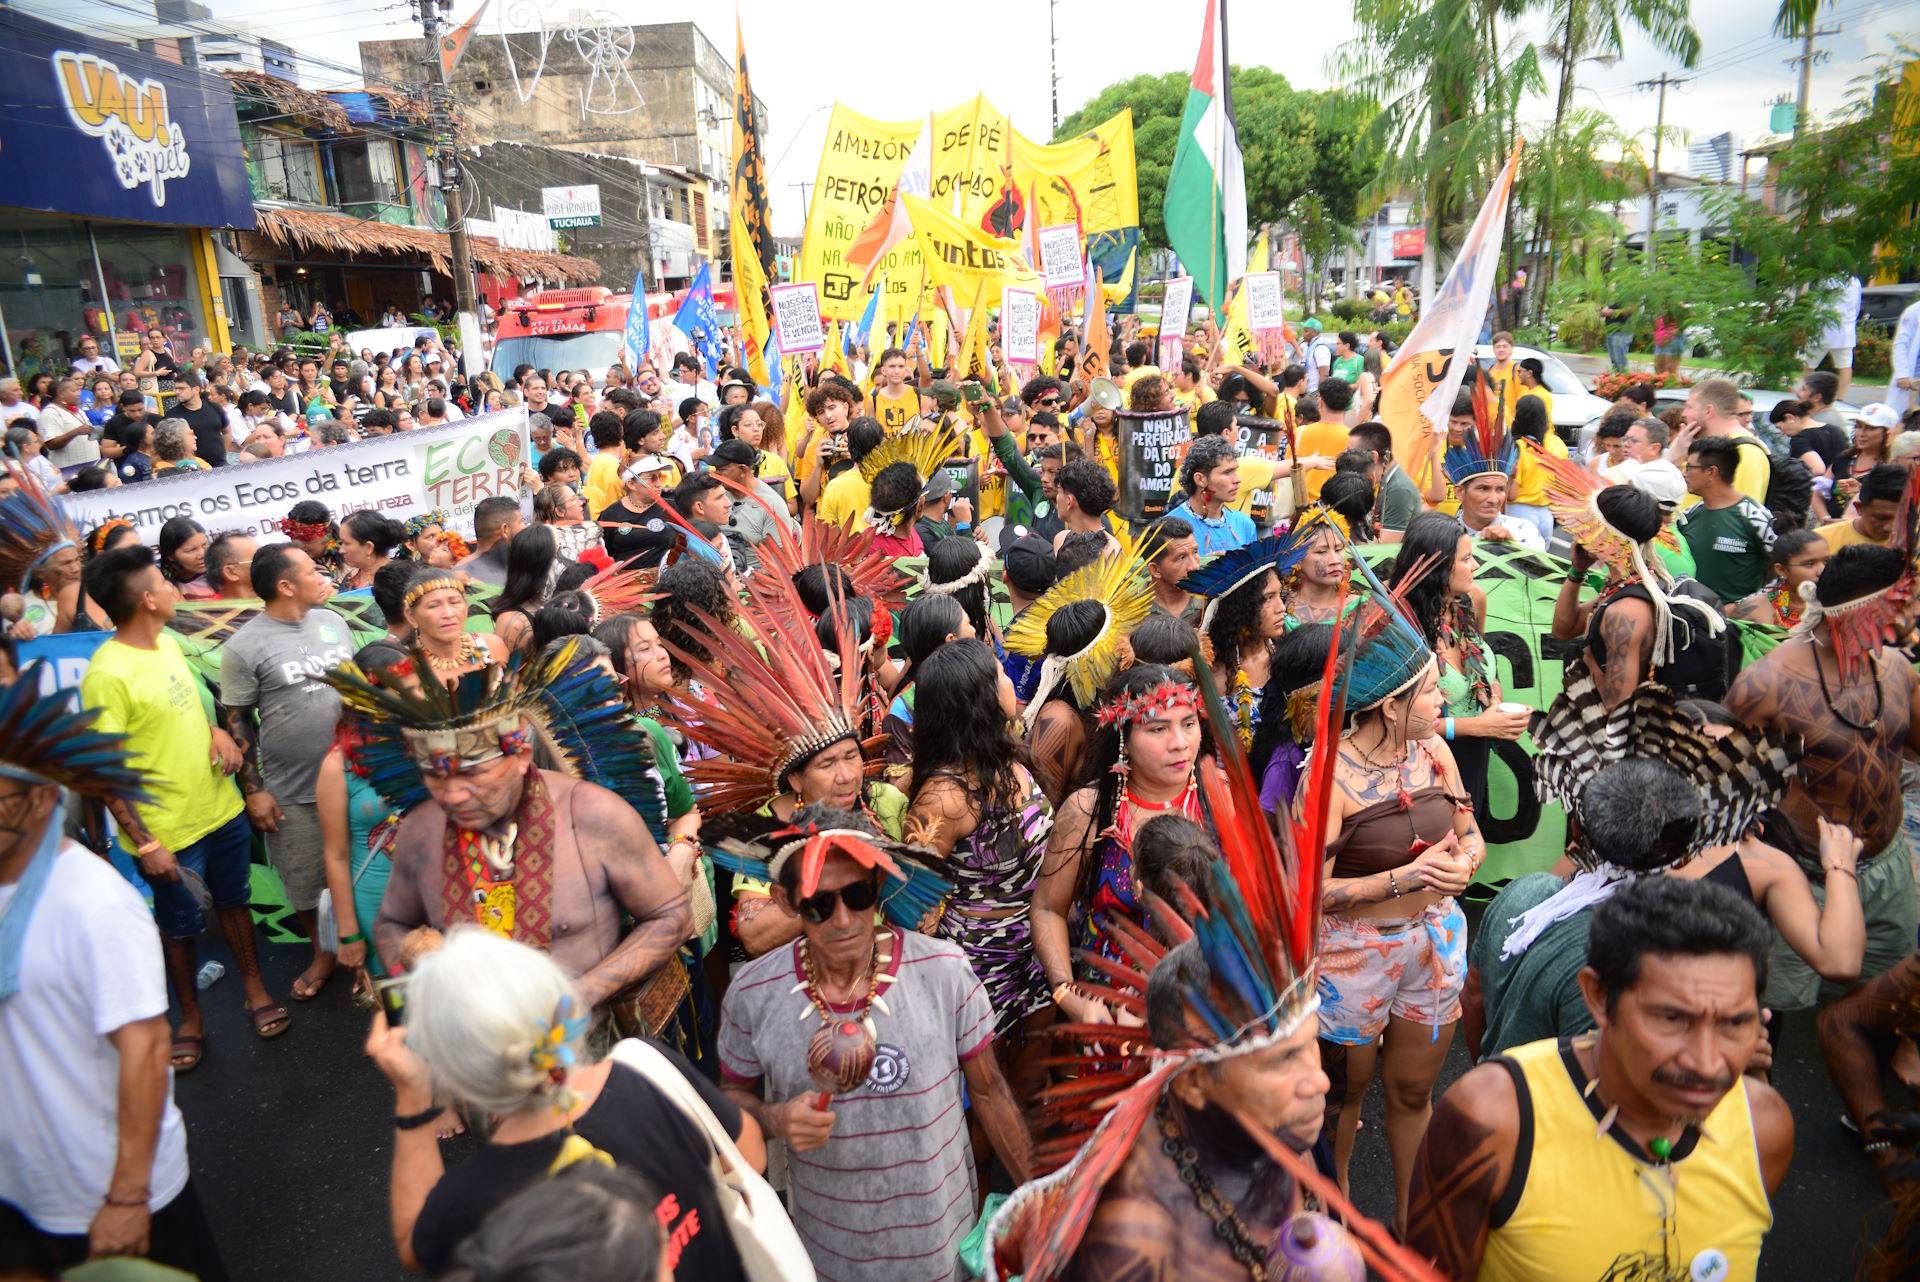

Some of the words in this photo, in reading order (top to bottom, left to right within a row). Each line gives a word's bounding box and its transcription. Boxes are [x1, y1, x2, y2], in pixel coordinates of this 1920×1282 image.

[60, 58, 170, 147] UAU!
[833, 130, 917, 160] AMAZÔN
[942, 123, 970, 151] DE
[979, 120, 1001, 152] PÉ
[147, 128, 187, 200] pet
[546, 199, 598, 214] RIBEIRINHO
[554, 216, 594, 228] TUCHAUA
[824, 215, 854, 240] NÃO
[926, 232, 1006, 269] untos
[778, 295, 814, 310] NOSSAS
[780, 304, 816, 319] FLORESTAS
[782, 318, 795, 329] NÃO
[796, 313, 817, 326] ESTÃO
[792, 324, 819, 338] VENDA
[1413, 373, 1431, 439] SOCIASTA
[1143, 447, 1160, 461] DA
[1162, 445, 1182, 460] FOZ
[1154, 462, 1171, 477] DO
[200, 494, 231, 514] os
[234, 480, 300, 508] Ecos
[305, 469, 341, 494] da
[344, 457, 411, 487] terra
[1139, 477, 1172, 491] AMAZ
[343, 493, 414, 518] Natureza
